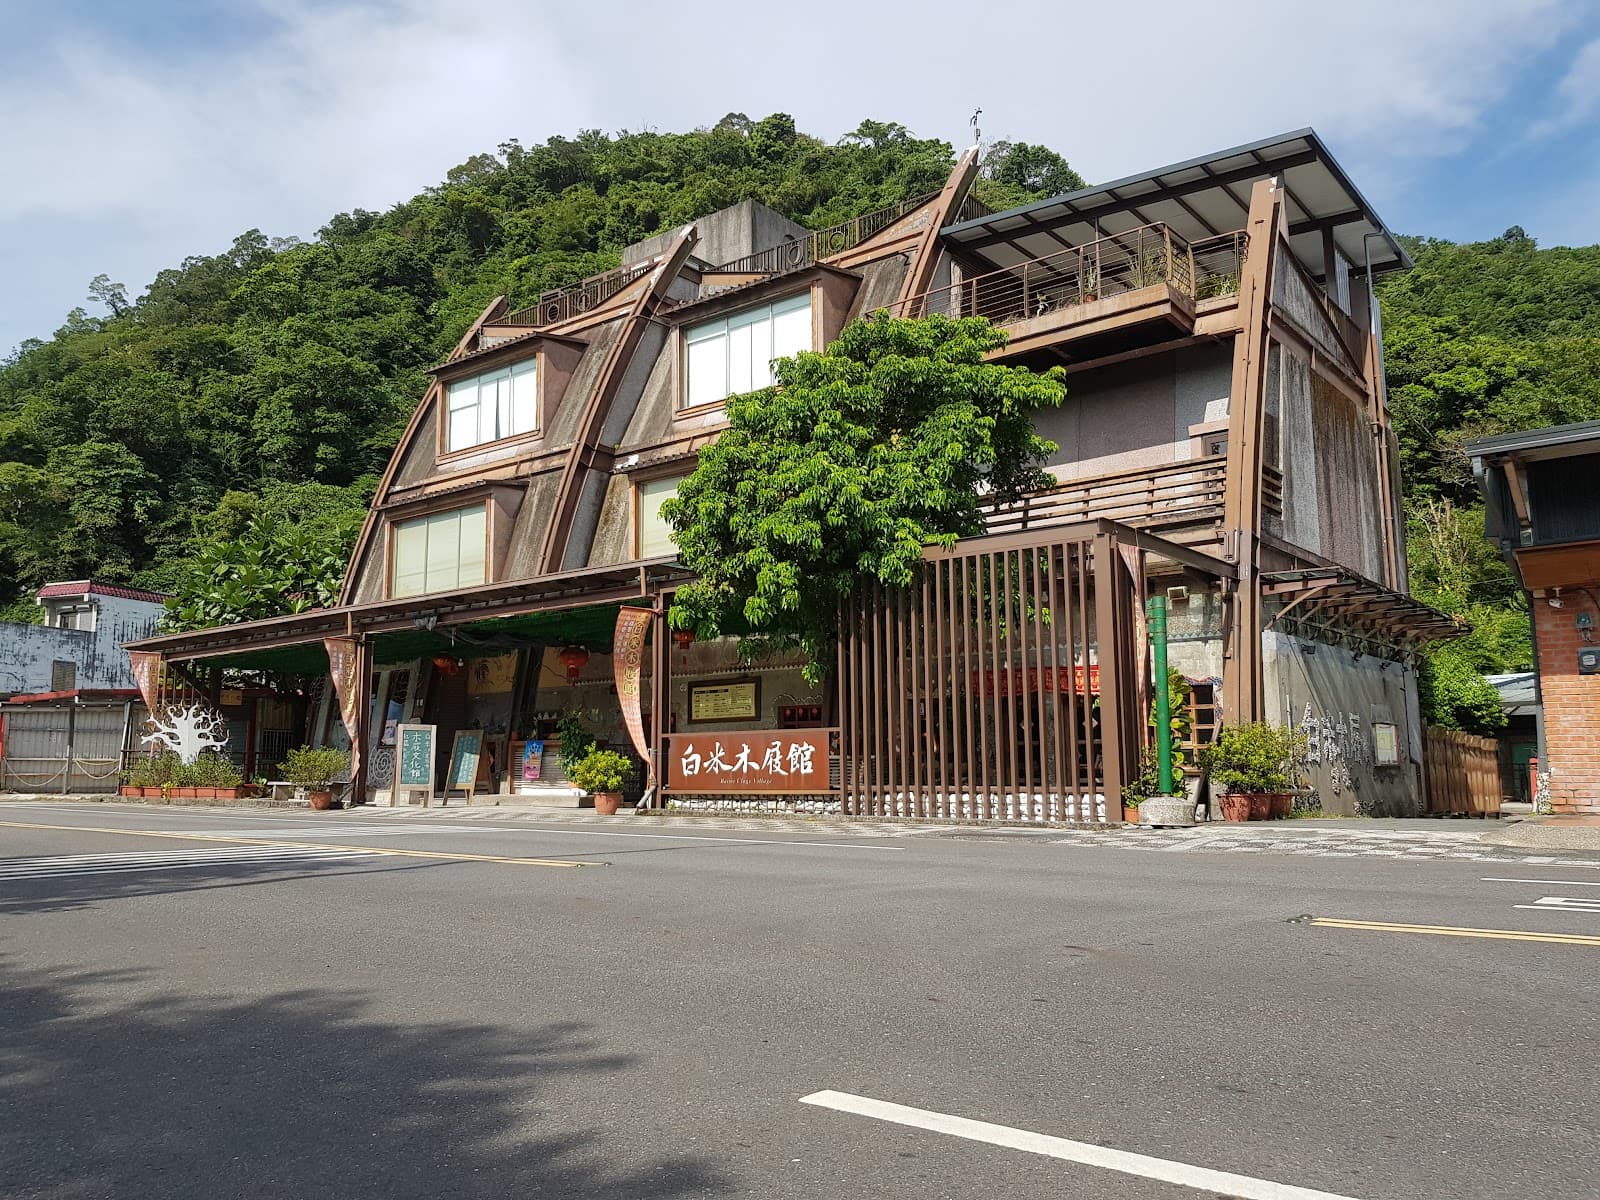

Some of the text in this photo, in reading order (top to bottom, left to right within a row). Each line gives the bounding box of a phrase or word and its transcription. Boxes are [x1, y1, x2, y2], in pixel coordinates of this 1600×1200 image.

[681, 740, 816, 776] 白米木屐館
